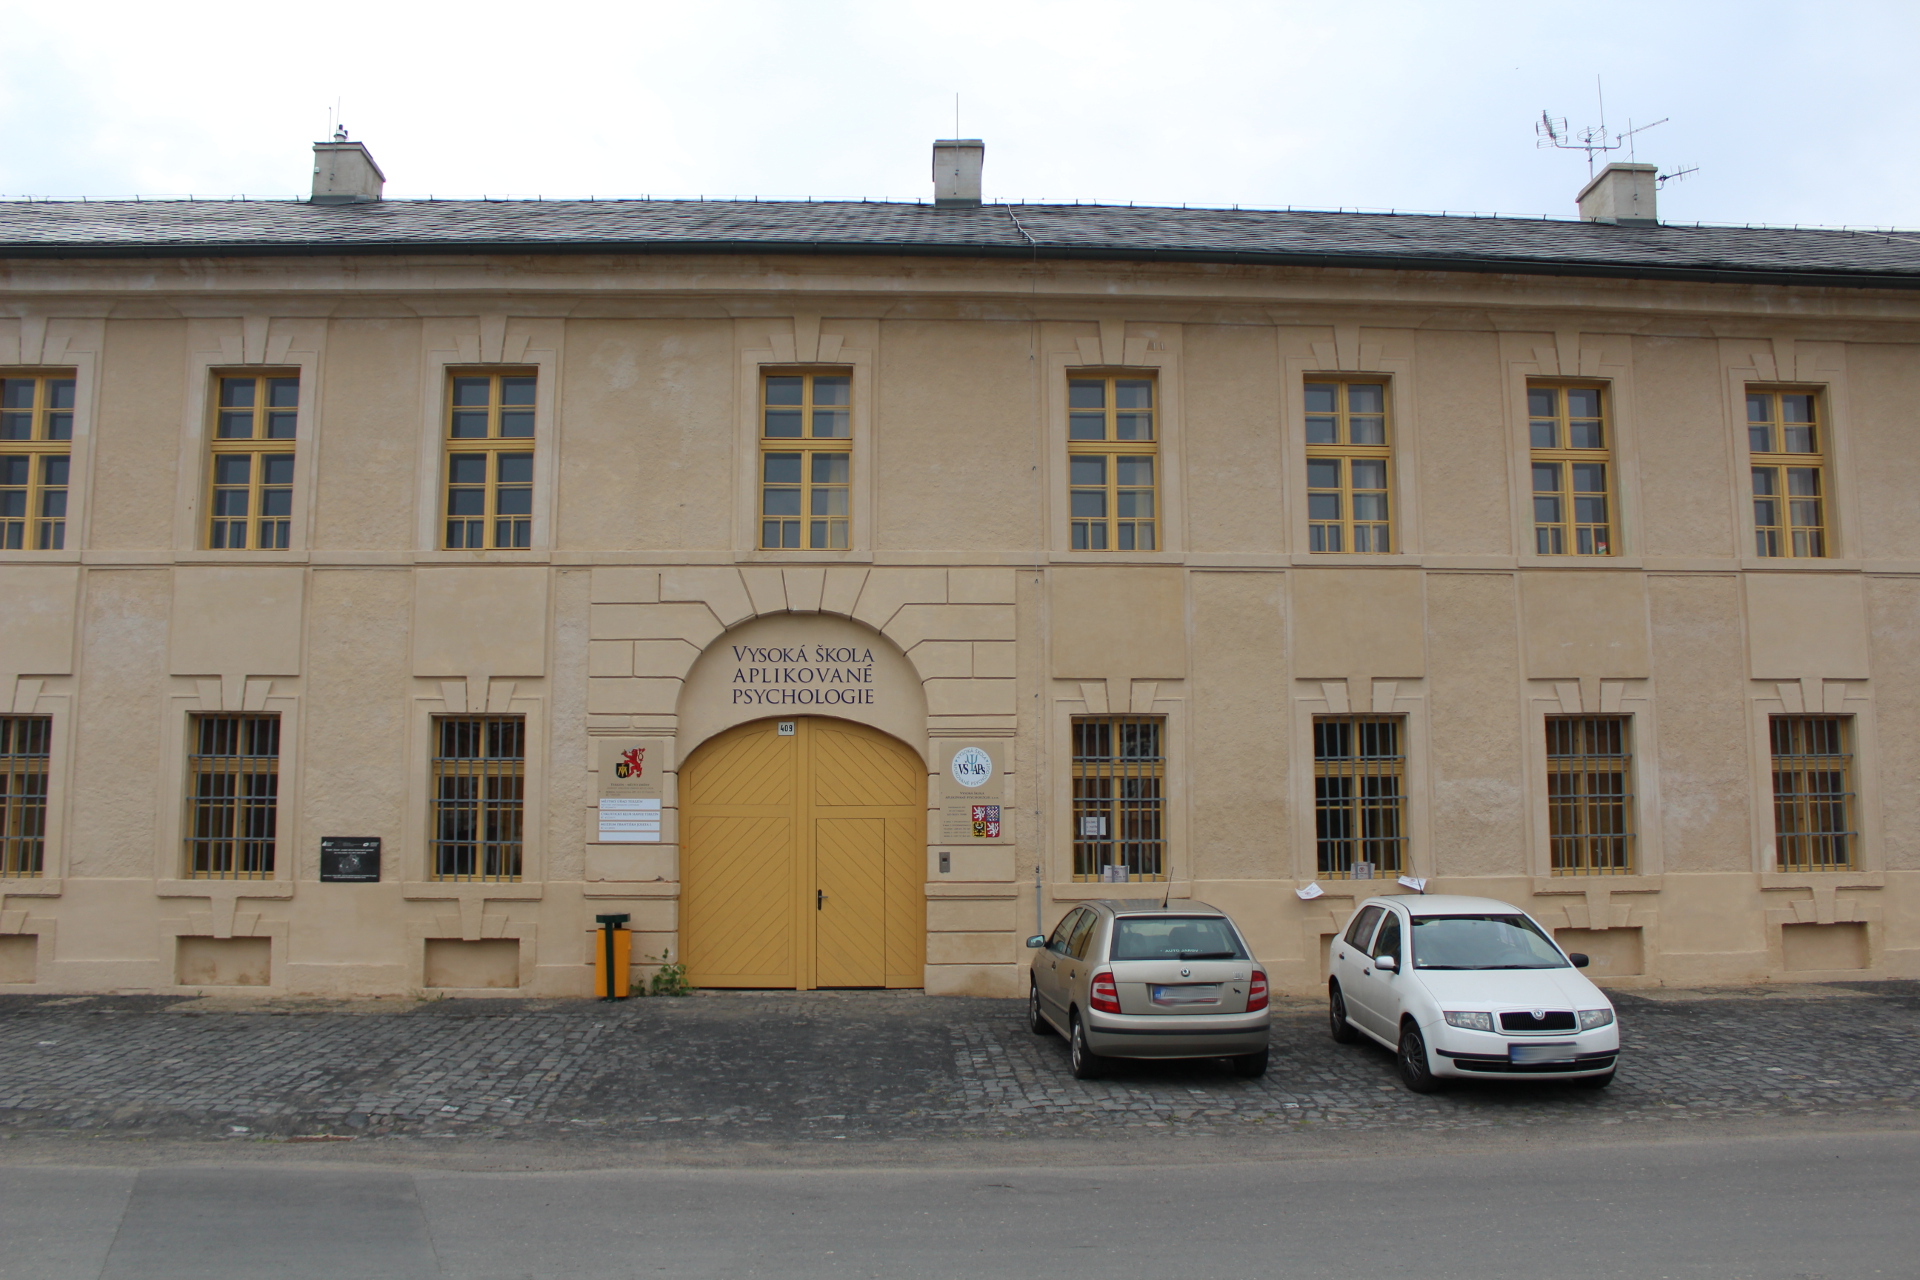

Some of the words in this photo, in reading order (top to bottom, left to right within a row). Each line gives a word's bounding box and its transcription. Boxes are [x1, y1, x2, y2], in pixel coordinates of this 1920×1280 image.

[732, 644, 809, 663] VYSOKÁ
[815, 644, 875, 663] ŠKOLA
[732, 663, 873, 683] APLIKOVANÉ
[732, 688, 874, 705] PSYCHOLOGIE
[780, 724, 793, 732] 409
